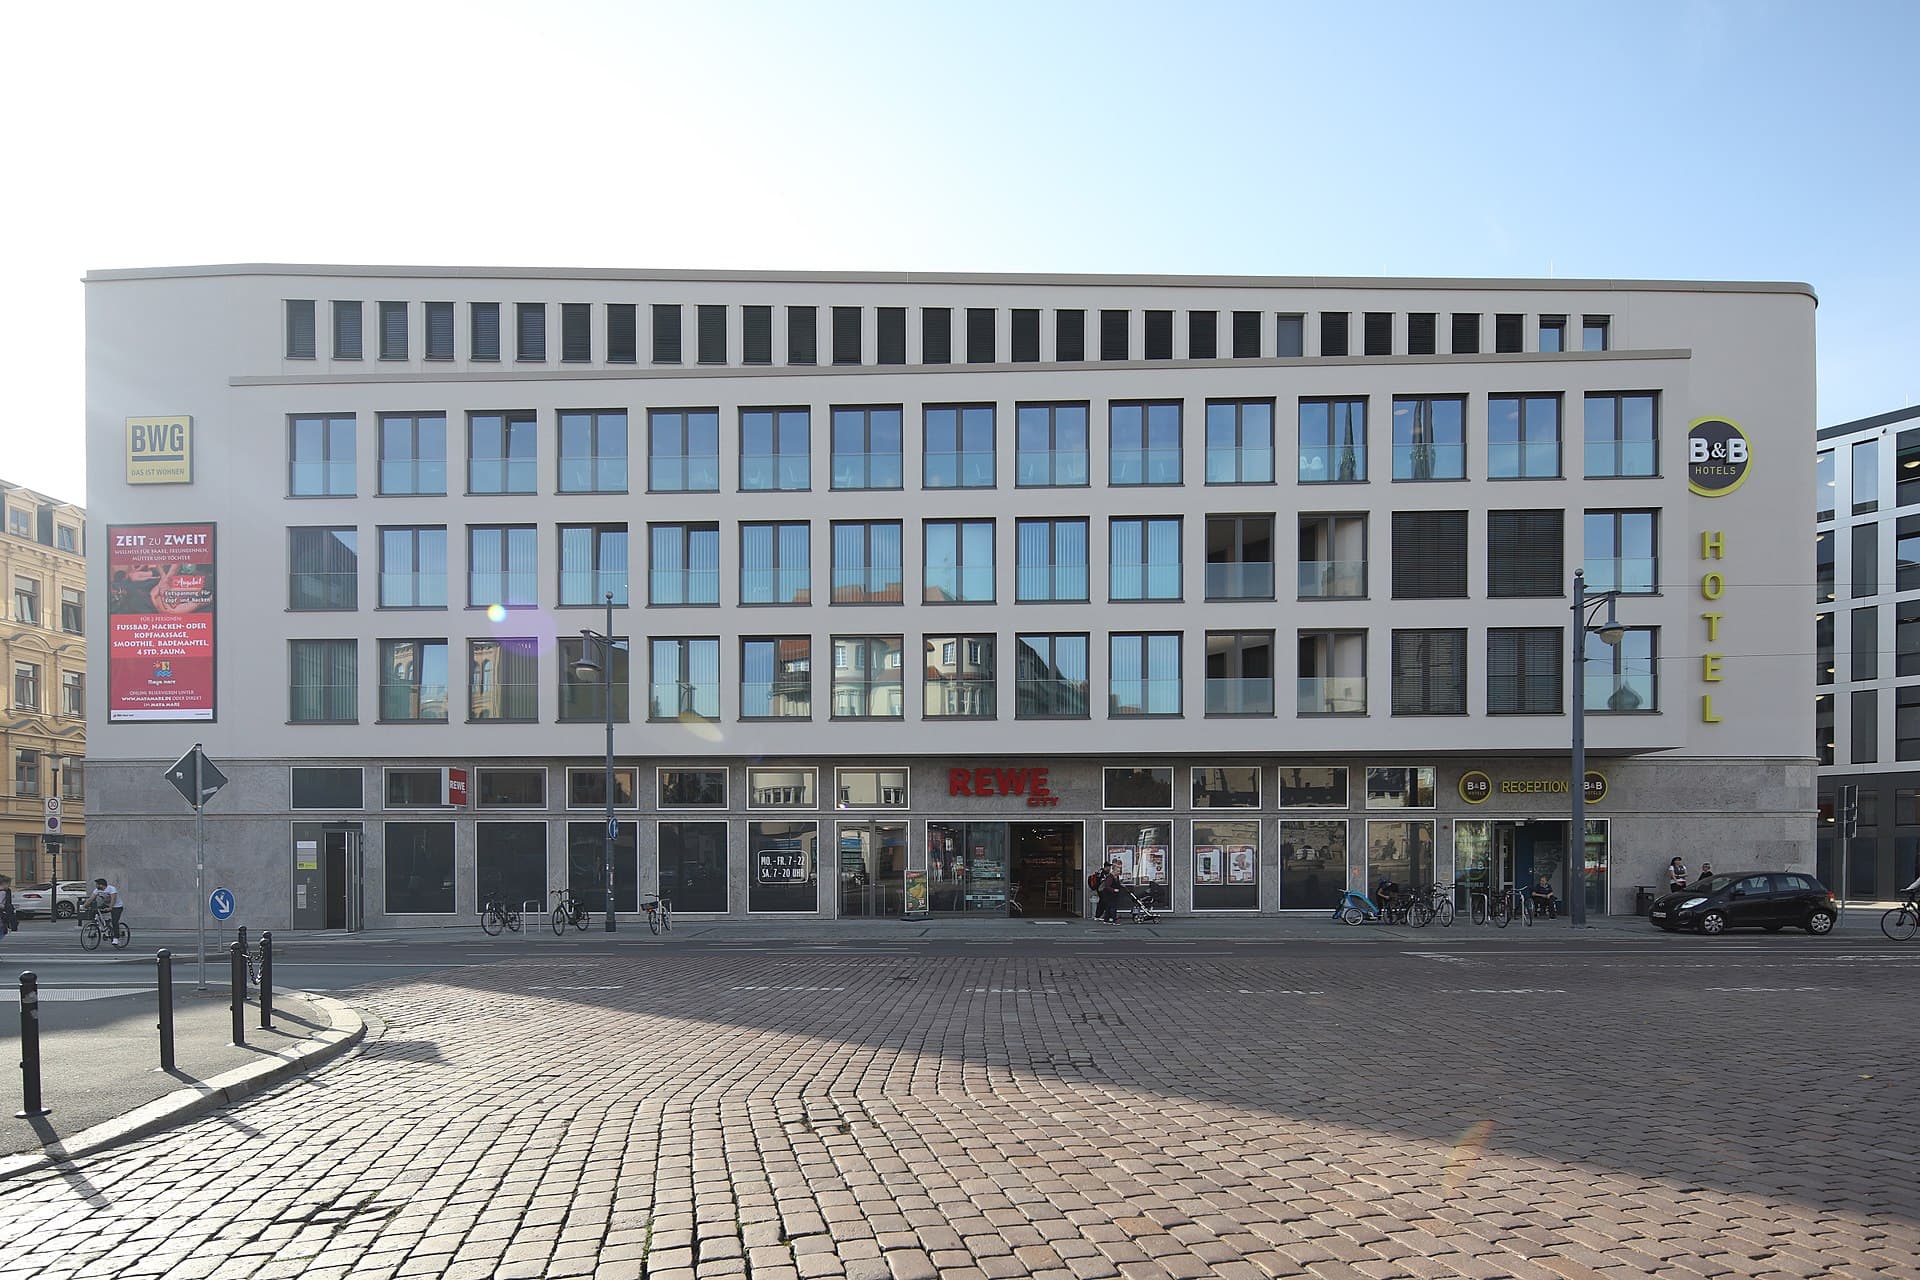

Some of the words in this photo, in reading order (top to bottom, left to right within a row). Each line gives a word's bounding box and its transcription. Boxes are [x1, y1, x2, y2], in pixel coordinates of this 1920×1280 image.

[131, 424, 184, 452] BWG
[1690, 437, 1748, 463] B&B
[145, 468, 155, 476] IST
[156, 468, 184, 476] WOHNEN
[1695, 466, 1736, 475] HOTELS
[116, 535, 146, 546] ZEIT
[164, 533, 207, 545] ZWEIT
[116, 624, 151, 632] FUSSBAD,
[1701, 531, 1725, 723] HOTEL
[134, 631, 189, 639] KOPFMASSAGE,
[449, 780, 466, 791] REWE
[949, 767, 1050, 797] REWE
[1467, 781, 1487, 790] B&B
[1502, 781, 1569, 793] RECEPTION
[1584, 781, 1603, 790] B&B
[1026, 797, 1059, 807] CITY
[761, 868, 772, 878] SA.
[792, 868, 805, 878] UHR
